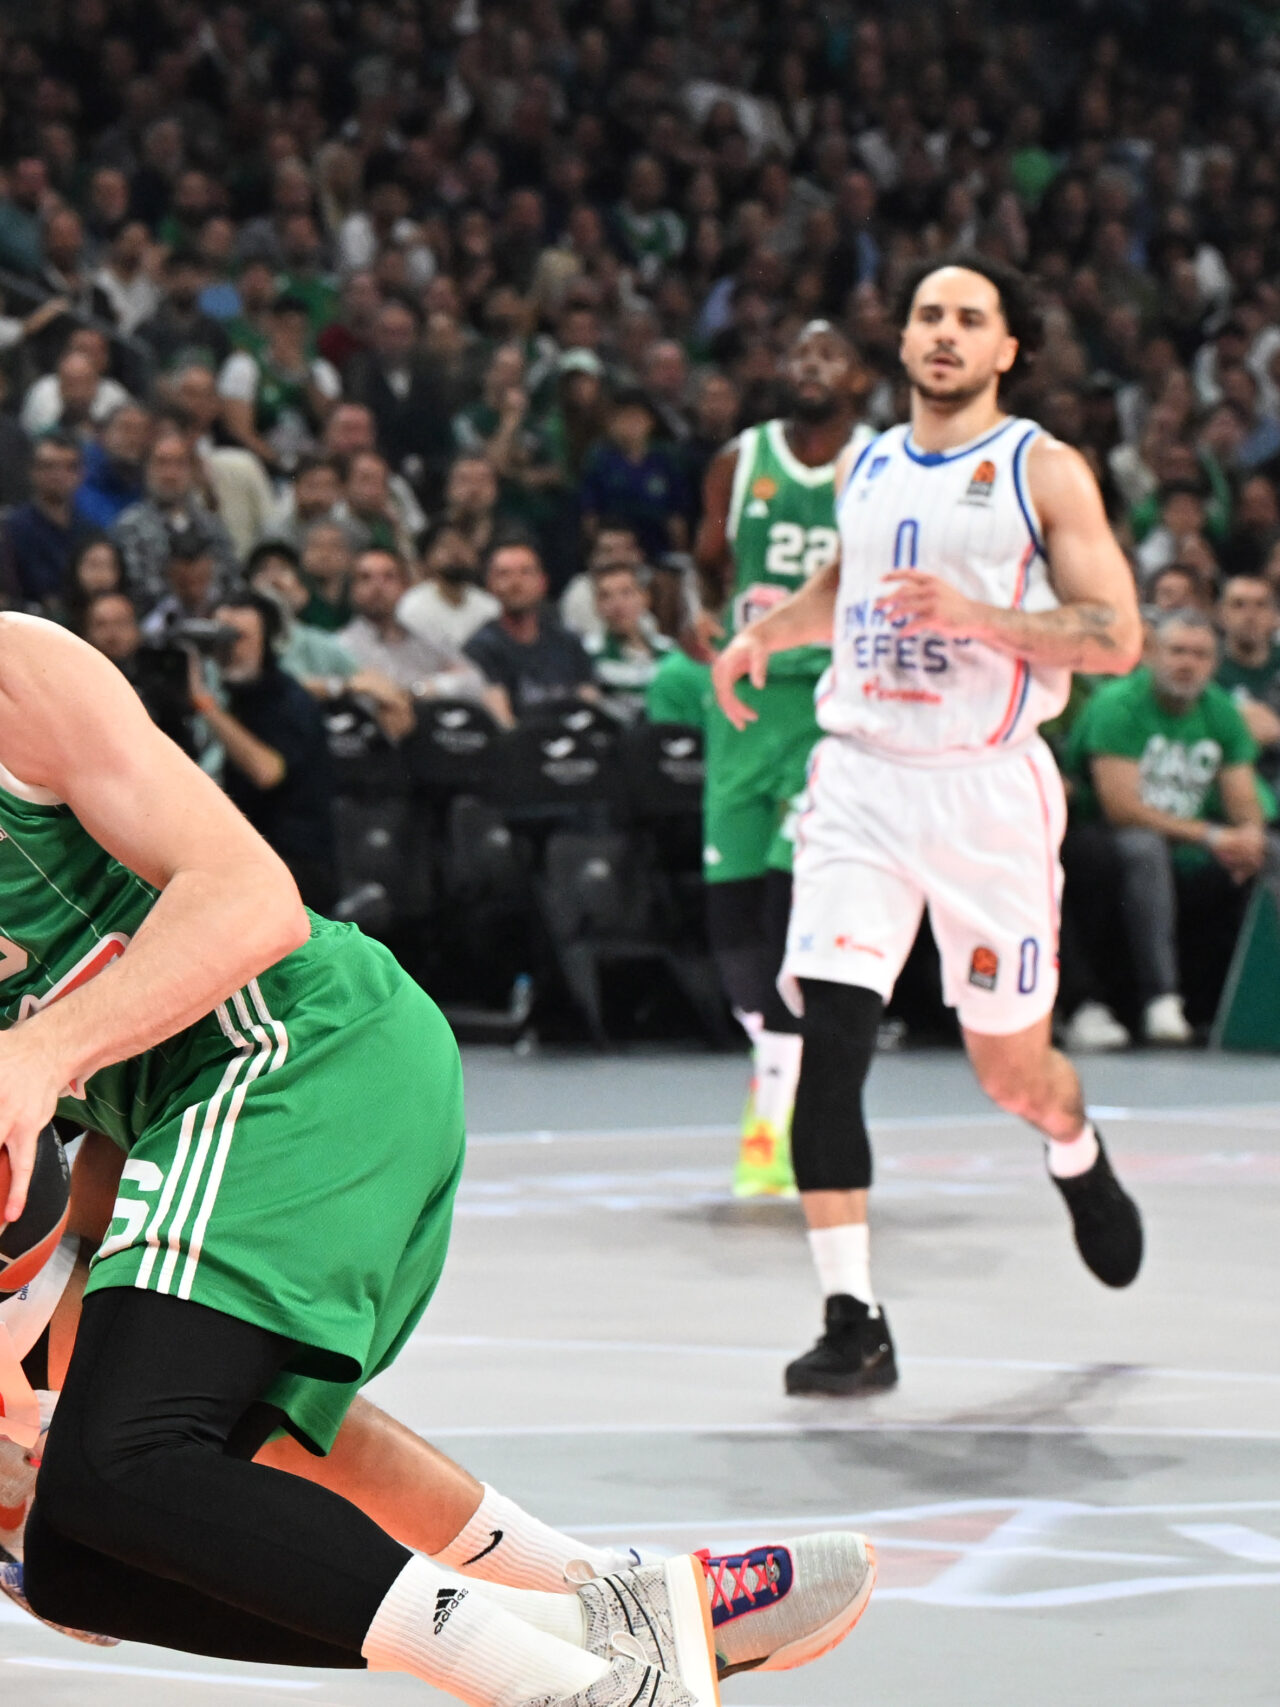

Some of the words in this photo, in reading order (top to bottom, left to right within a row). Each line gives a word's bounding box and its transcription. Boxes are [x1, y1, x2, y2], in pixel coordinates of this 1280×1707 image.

[765, 521, 839, 577] 22
[853, 634, 949, 674] EFES
[1017, 936, 1039, 995] 0
[433, 1587, 469, 1636] adidas
